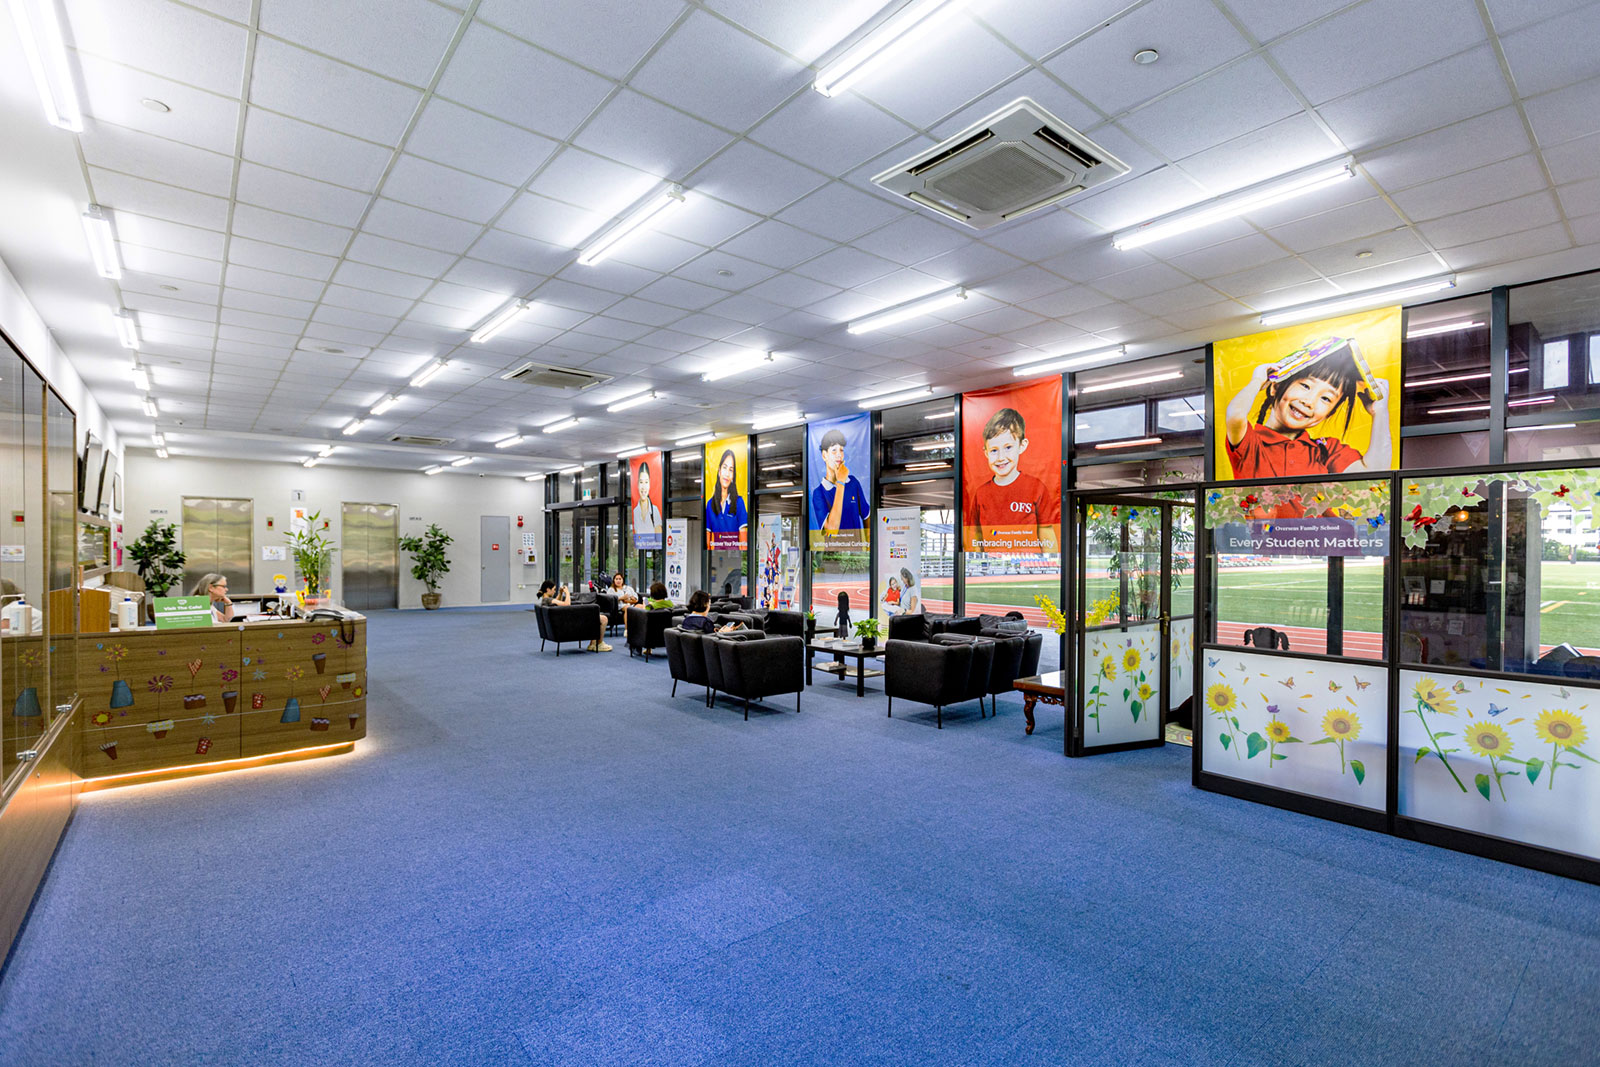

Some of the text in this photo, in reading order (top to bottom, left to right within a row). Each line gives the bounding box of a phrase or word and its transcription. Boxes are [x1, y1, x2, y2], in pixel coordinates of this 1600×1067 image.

[1010, 501, 1032, 514] OFS
[972, 539, 1054, 548] Embracing Inclusivity
[1229, 537, 1384, 550] Every Student Matters
